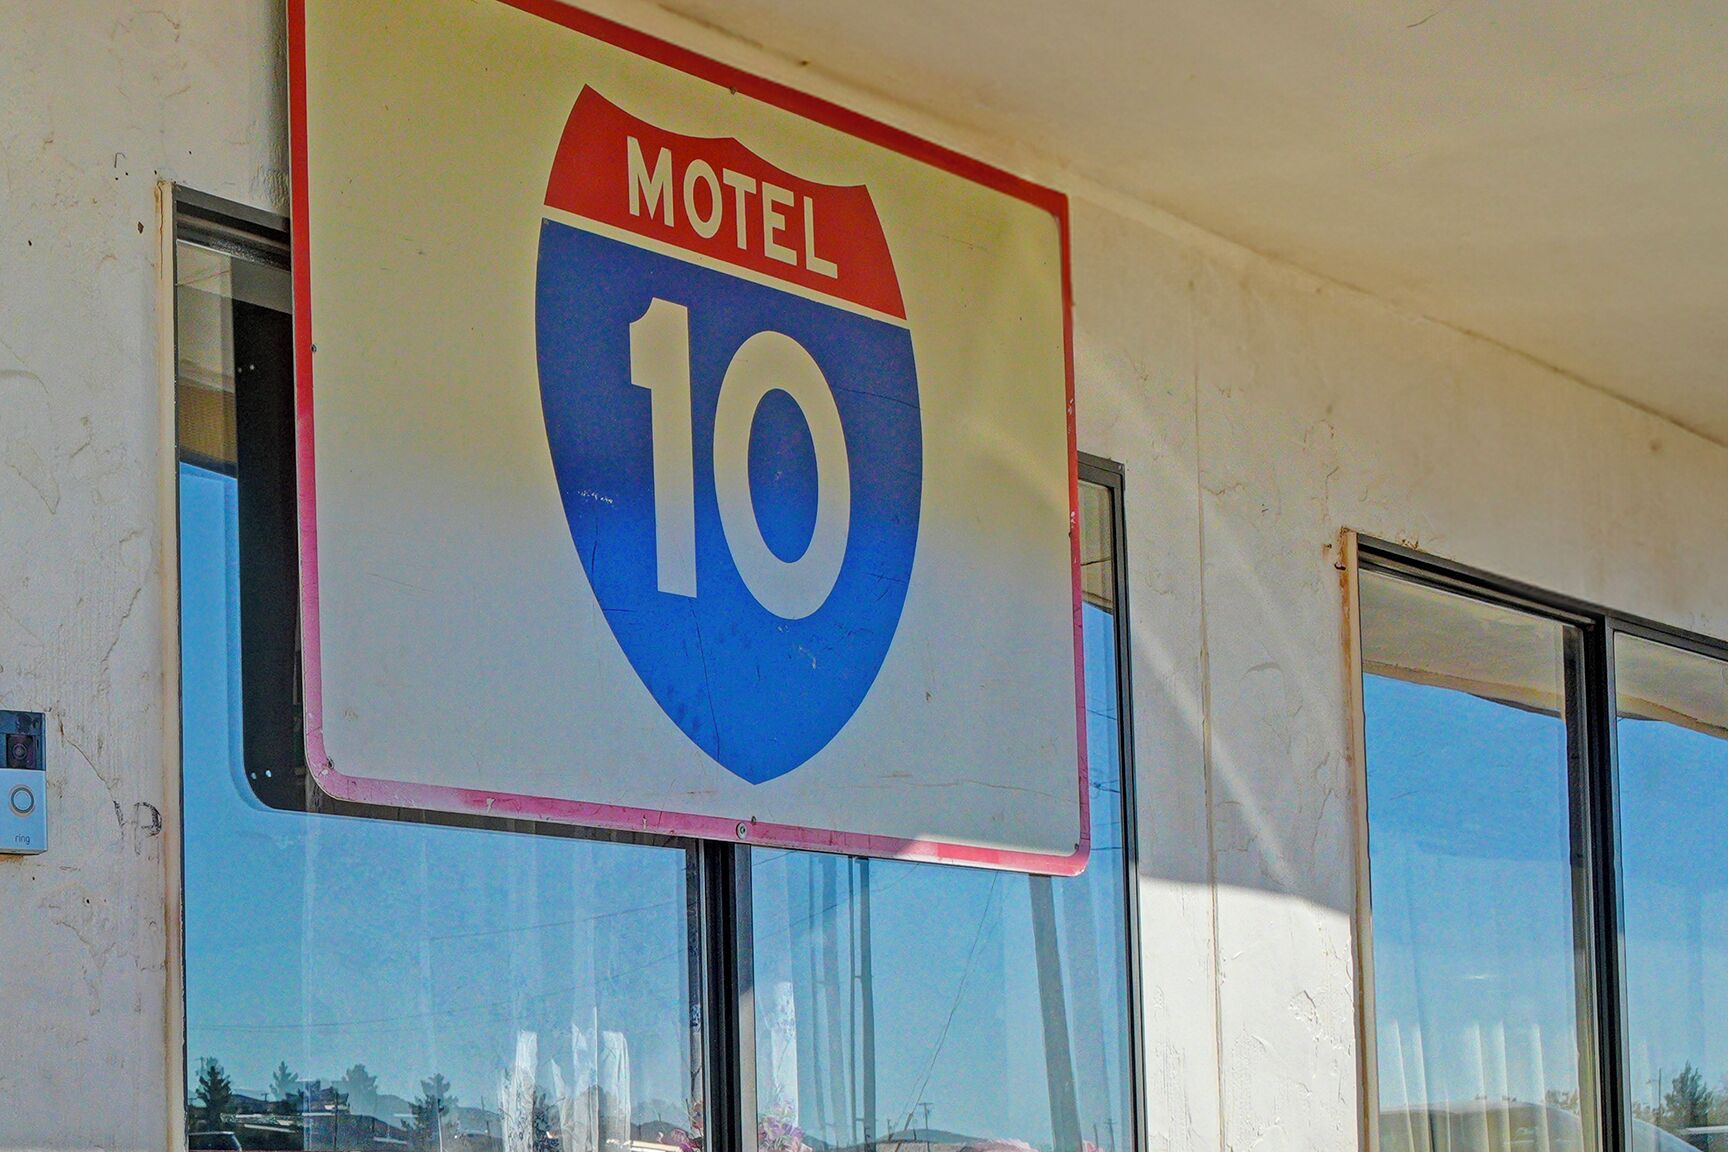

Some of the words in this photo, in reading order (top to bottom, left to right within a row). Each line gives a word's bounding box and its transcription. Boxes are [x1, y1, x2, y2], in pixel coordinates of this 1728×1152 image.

[626, 135, 838, 280] MOTEL
[628, 297, 852, 620] 10
[15, 834, 30, 845] ring
